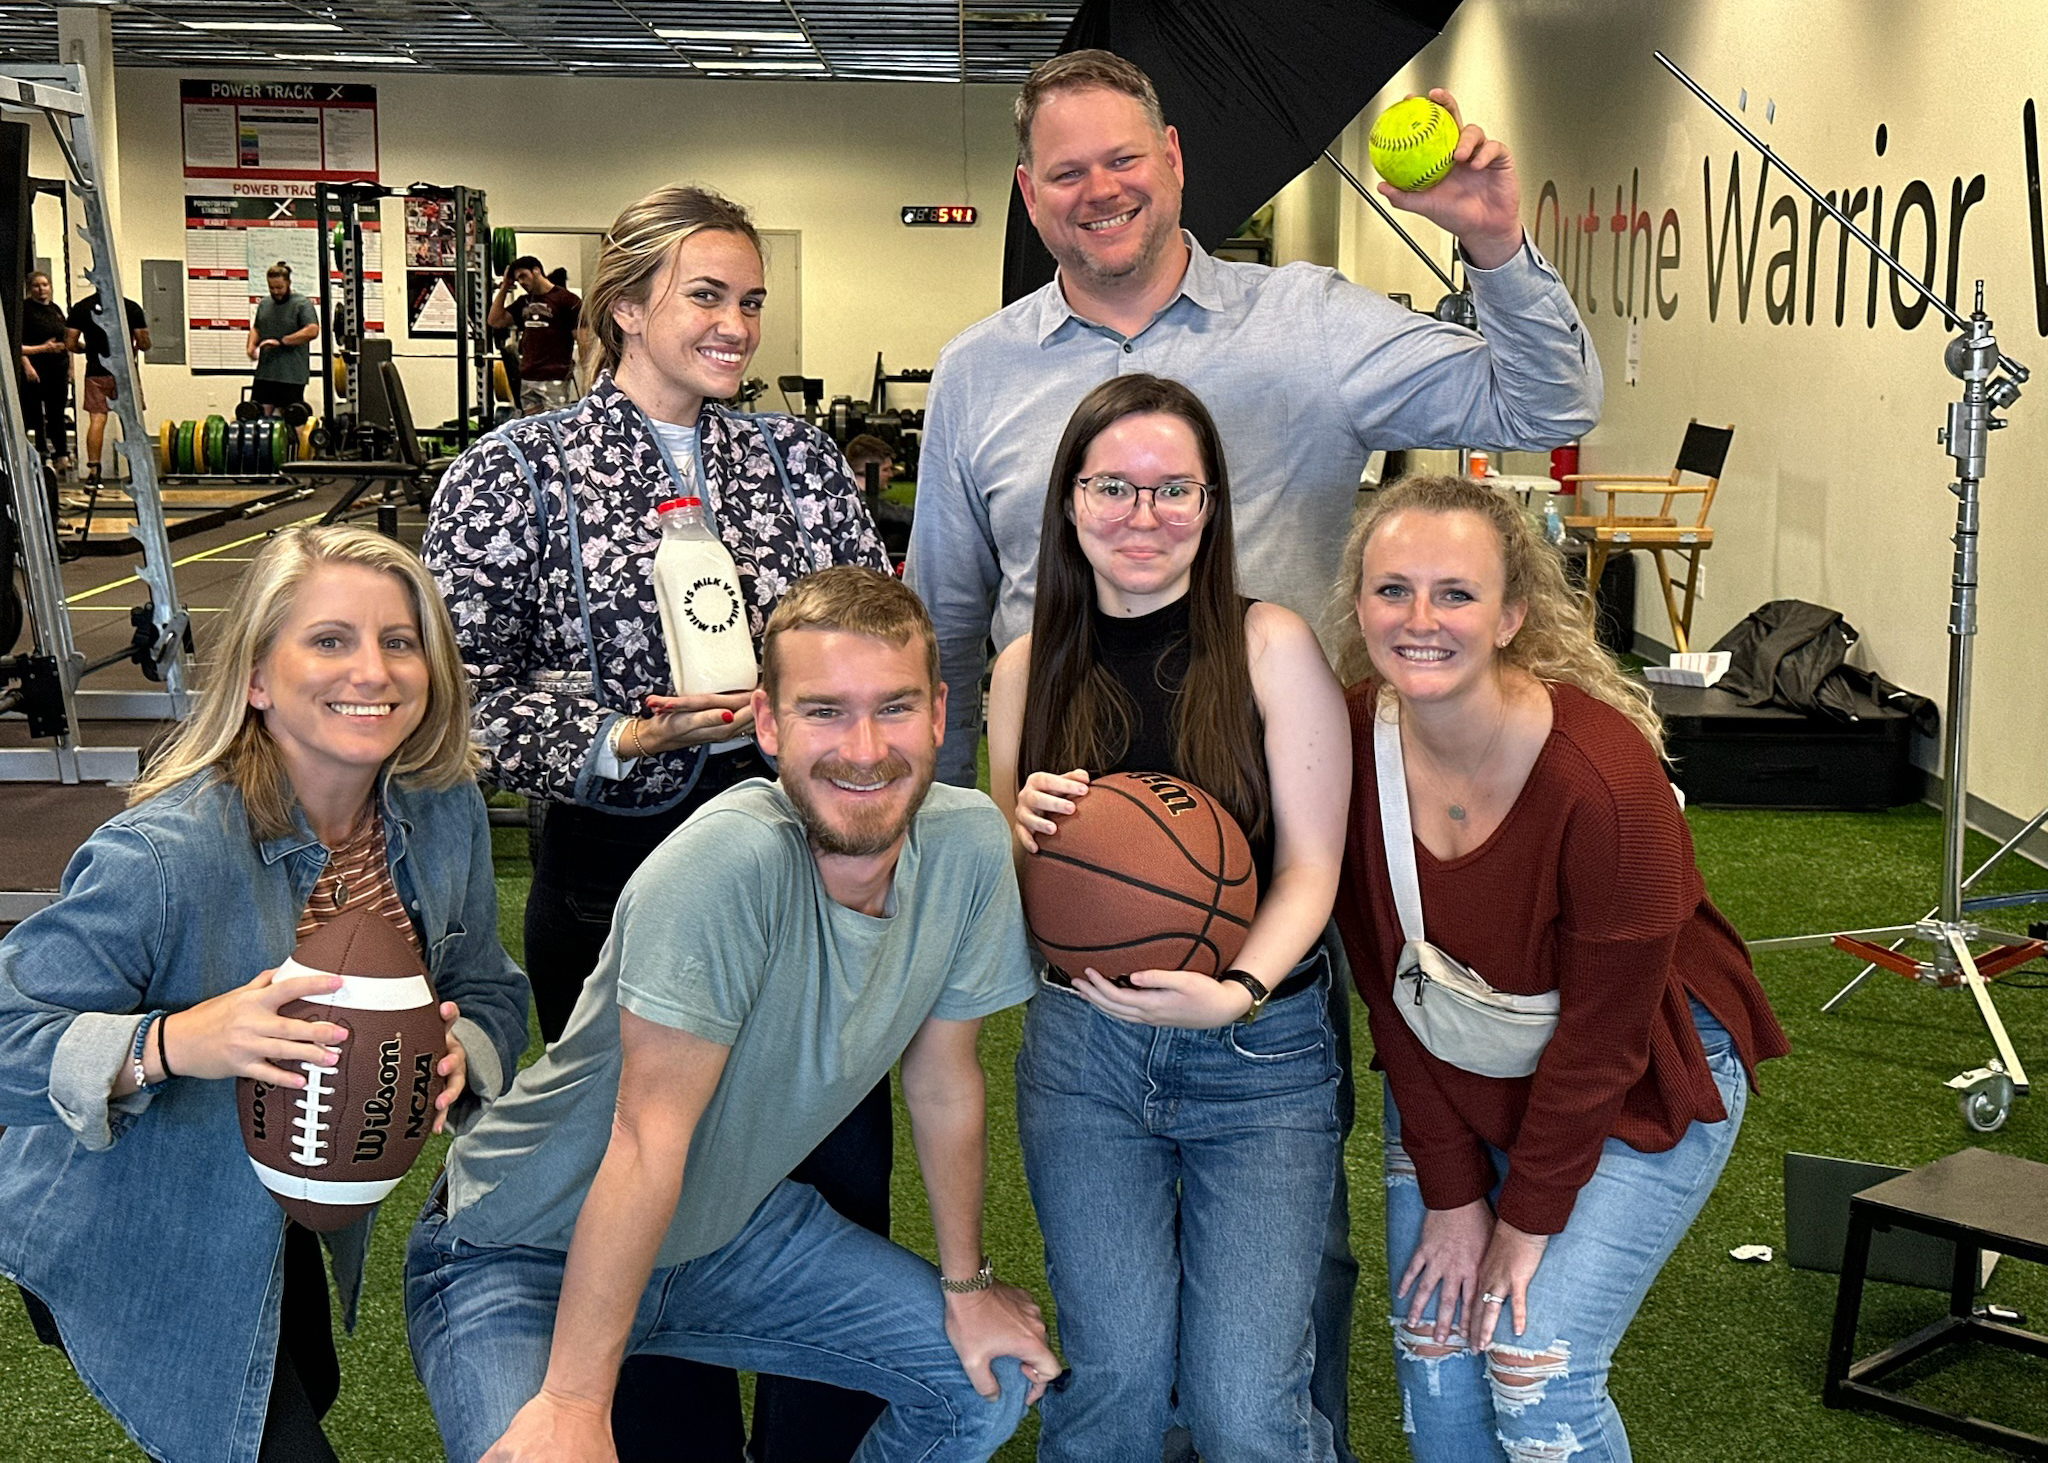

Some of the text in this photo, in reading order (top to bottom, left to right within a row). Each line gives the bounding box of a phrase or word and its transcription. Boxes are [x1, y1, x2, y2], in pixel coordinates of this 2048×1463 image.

[211, 83, 261, 98] POWER
[266, 85, 314, 99] TRACK
[233, 183, 317, 197] POWER TRAC
[1610, 166, 1682, 321] the
[1703, 122, 1986, 333] Warrior
[683, 577, 740, 634] MILK VS MILK VS MILK VS
[352, 1038, 402, 1164] Wilson
[404, 1052, 433, 1140] NCAA
